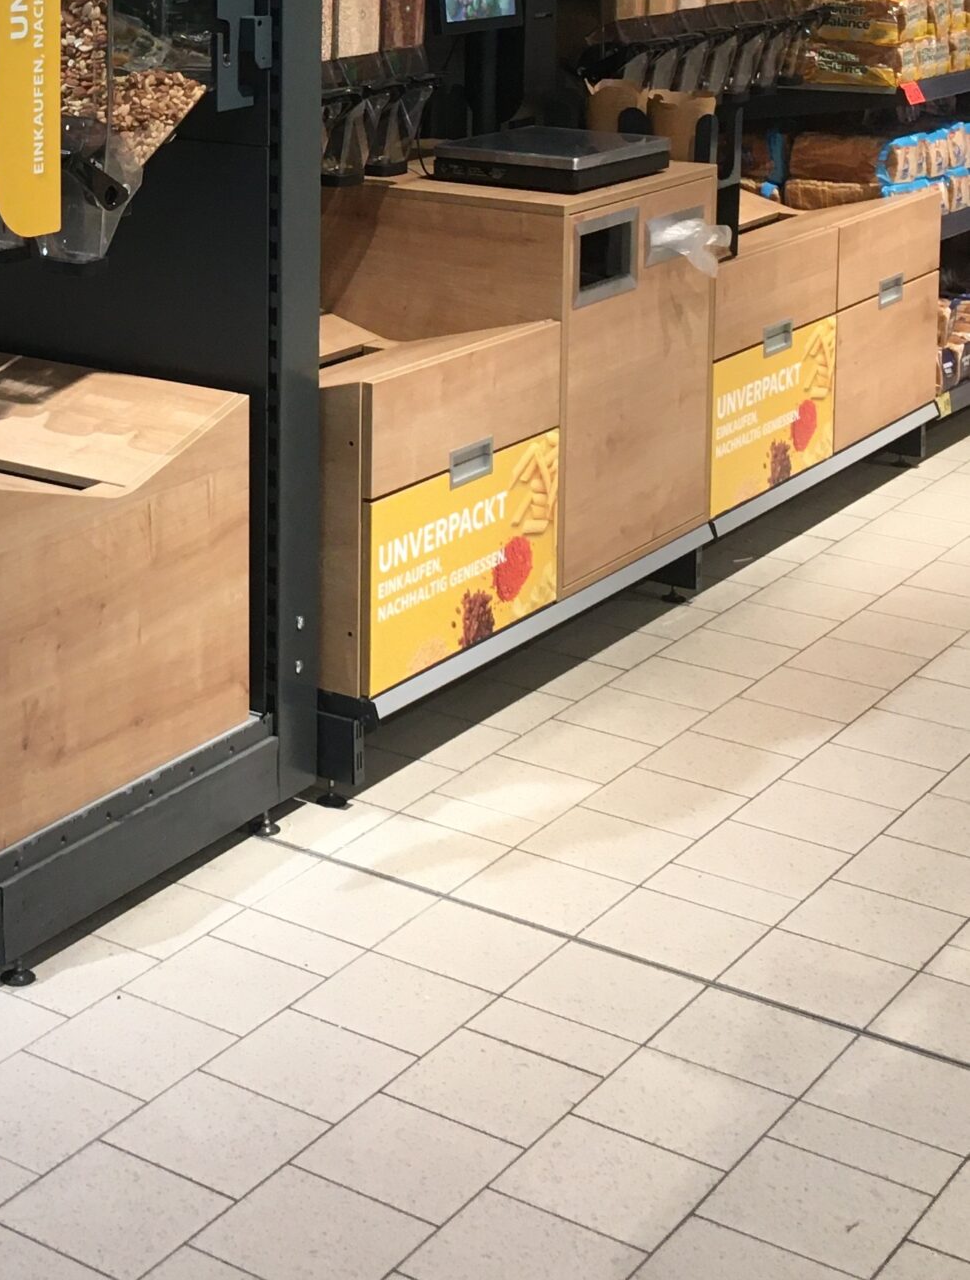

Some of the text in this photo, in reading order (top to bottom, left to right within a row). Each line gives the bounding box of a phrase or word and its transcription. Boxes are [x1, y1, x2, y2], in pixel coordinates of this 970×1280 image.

[33, 54, 46, 176] EINKAUFEN,
[716, 362, 802, 420] UNVERPACKT
[715, 427, 761, 459] NACHHALTIG
[716, 412, 758, 441] EINKAUFEN,
[378, 491, 508, 573] UNVERPACKT
[377, 557, 442, 599] EINKAUFEN,
[377, 548, 508, 621] NACHHALTIG GENIESSEN.
